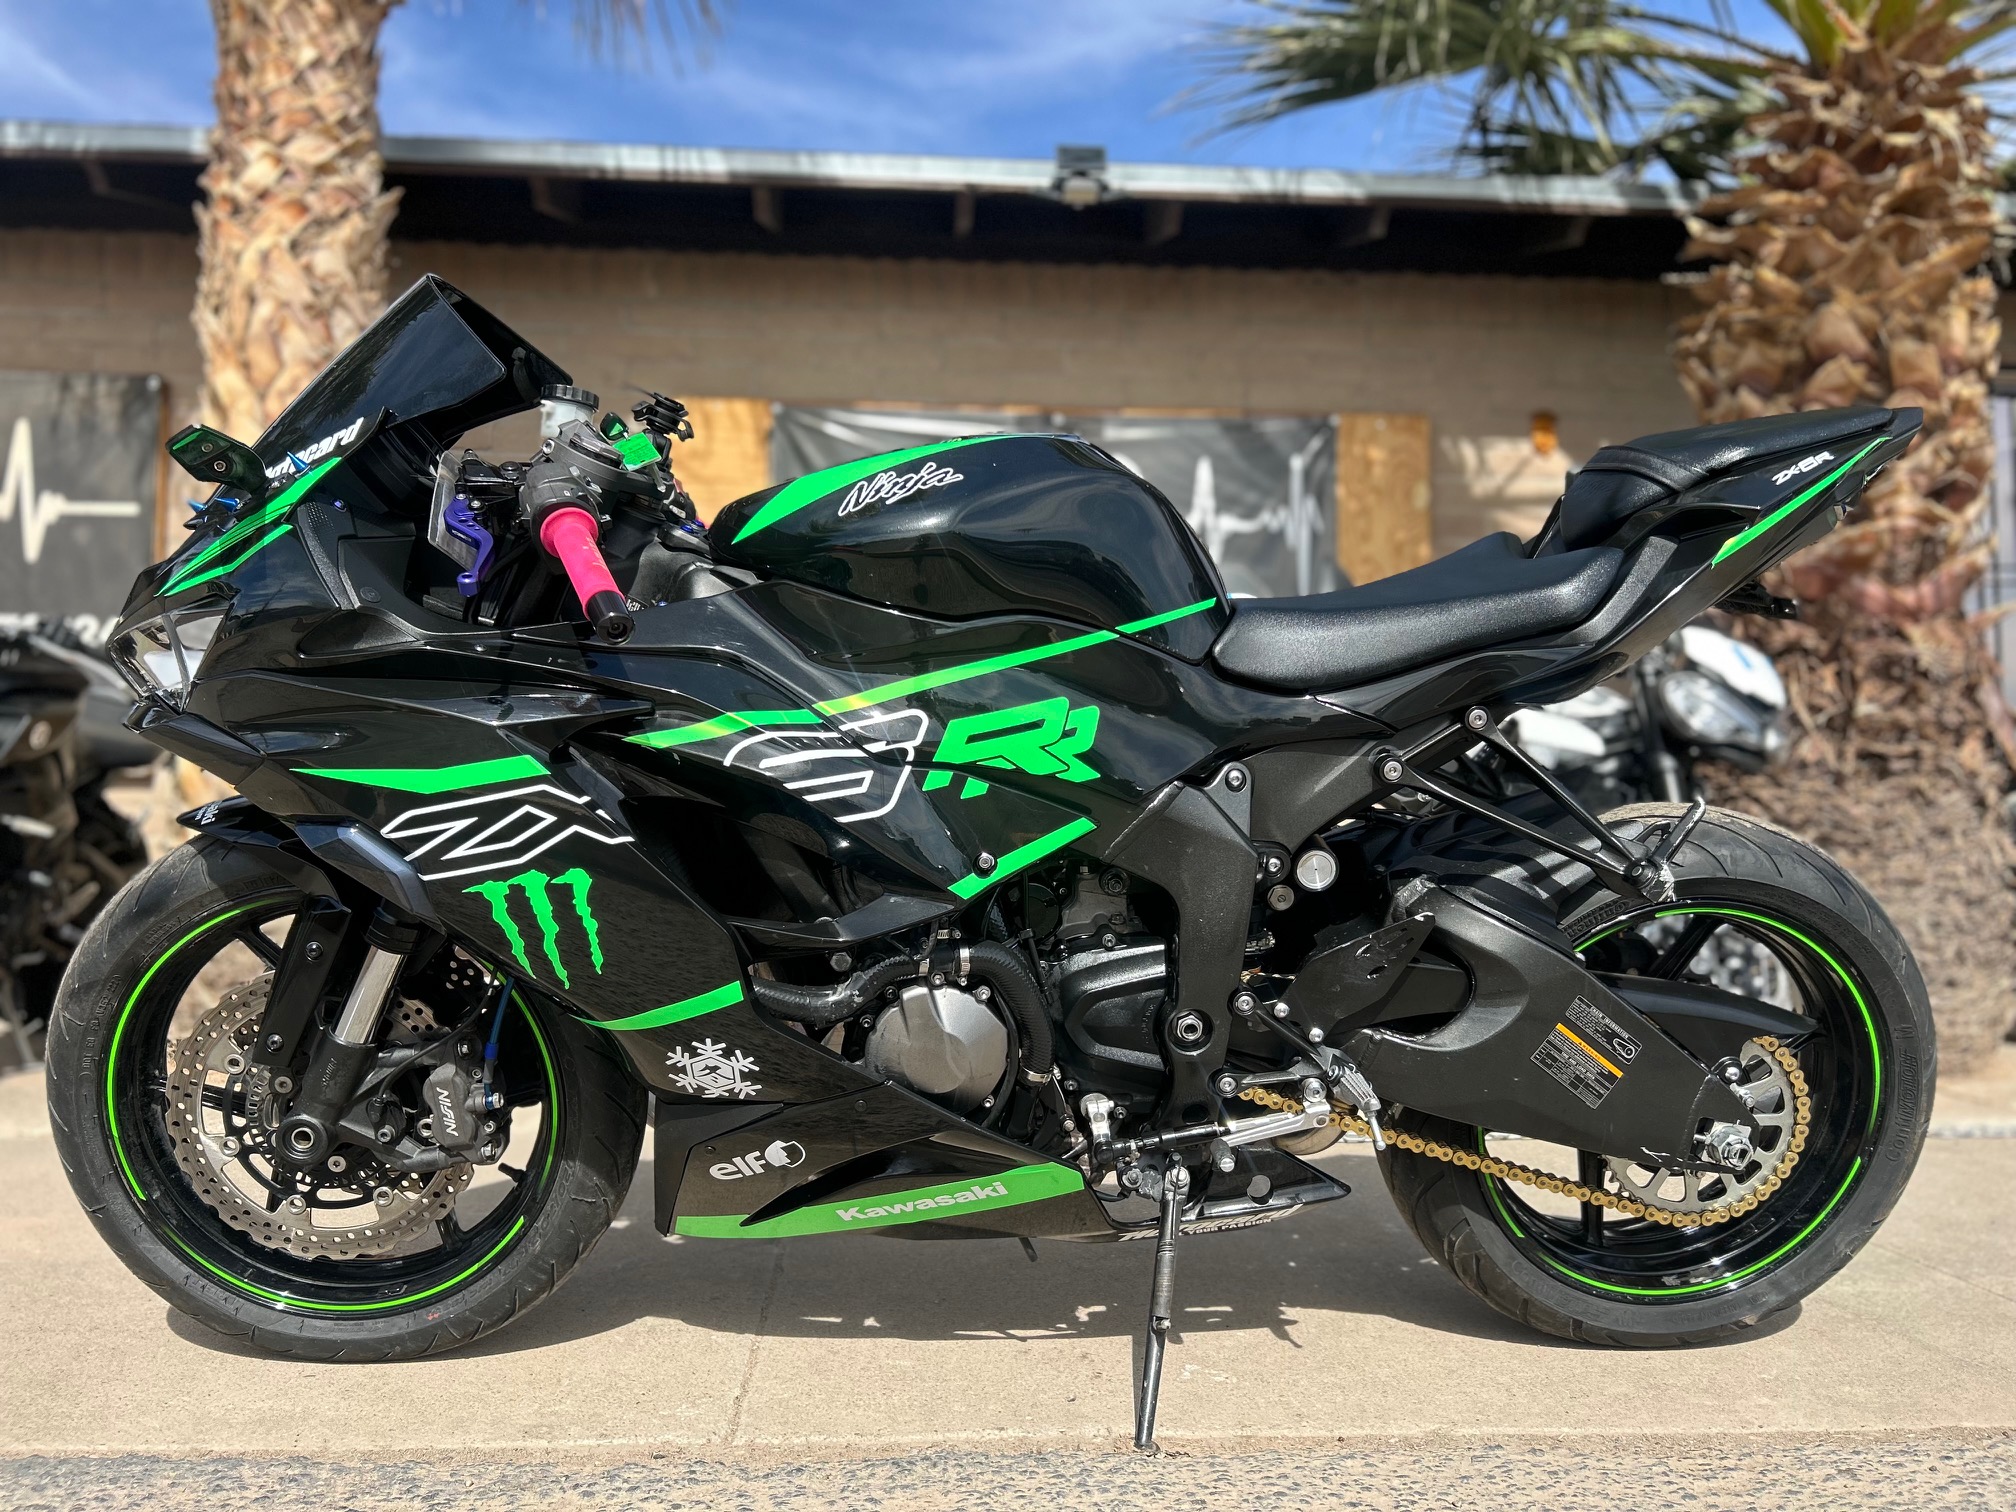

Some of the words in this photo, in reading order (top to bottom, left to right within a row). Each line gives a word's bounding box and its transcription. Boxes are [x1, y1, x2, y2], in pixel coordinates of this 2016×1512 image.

[838, 462, 964, 516] Ninja
[709, 1151, 767, 1180] elf
[836, 1181, 1009, 1222] Kawasaki
[1188, 1225, 1219, 1236] YOUR
[1221, 1218, 1273, 1231] PASSION
